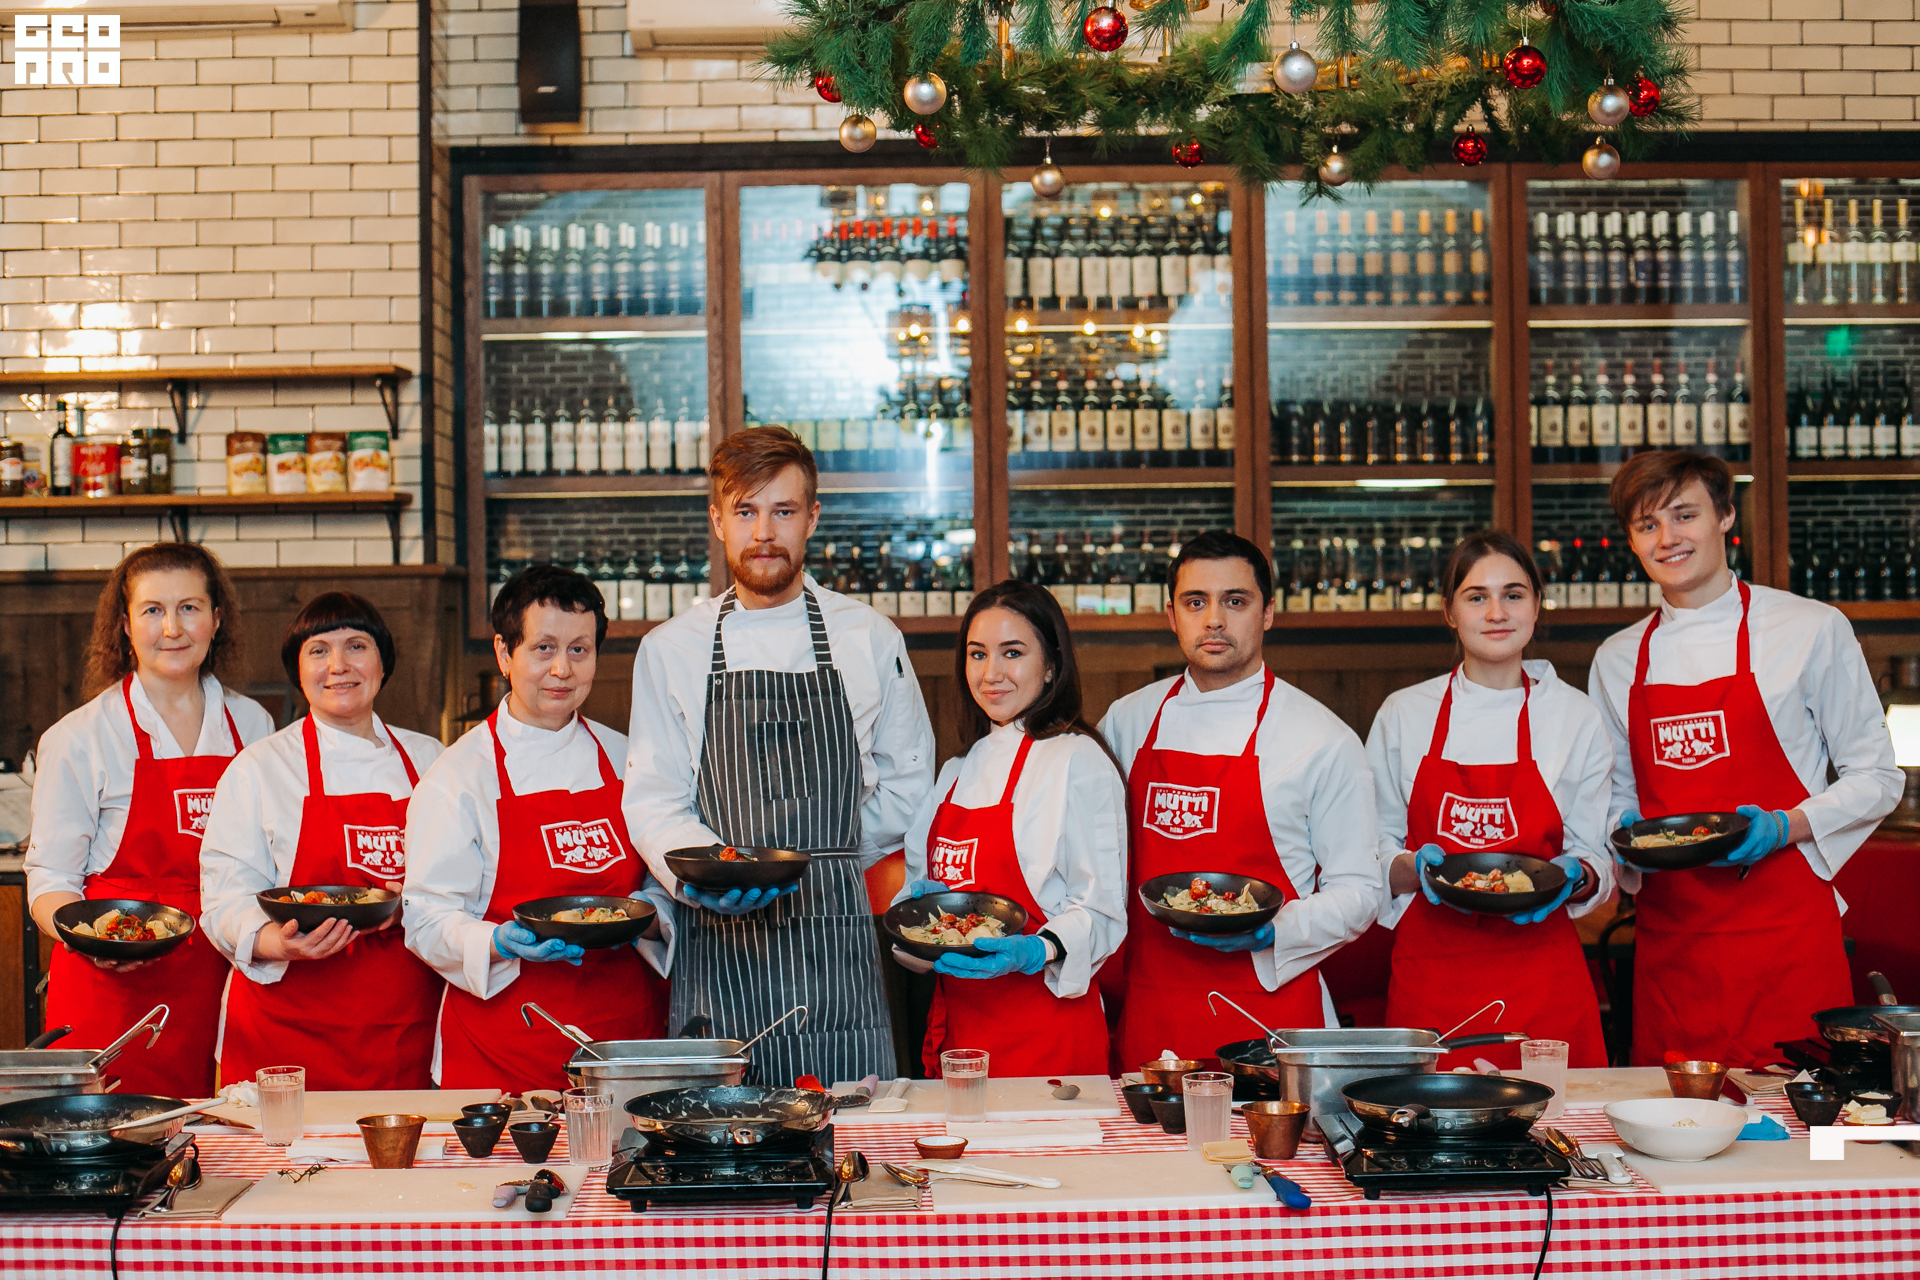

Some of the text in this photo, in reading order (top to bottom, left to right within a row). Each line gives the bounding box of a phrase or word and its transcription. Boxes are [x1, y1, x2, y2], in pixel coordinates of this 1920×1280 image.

[1658, 721, 1716, 743] MUTTI
[1155, 792, 1208, 812] MUTTI
[555, 828, 609, 849] MUTI
[931, 846, 969, 865] UTTI
